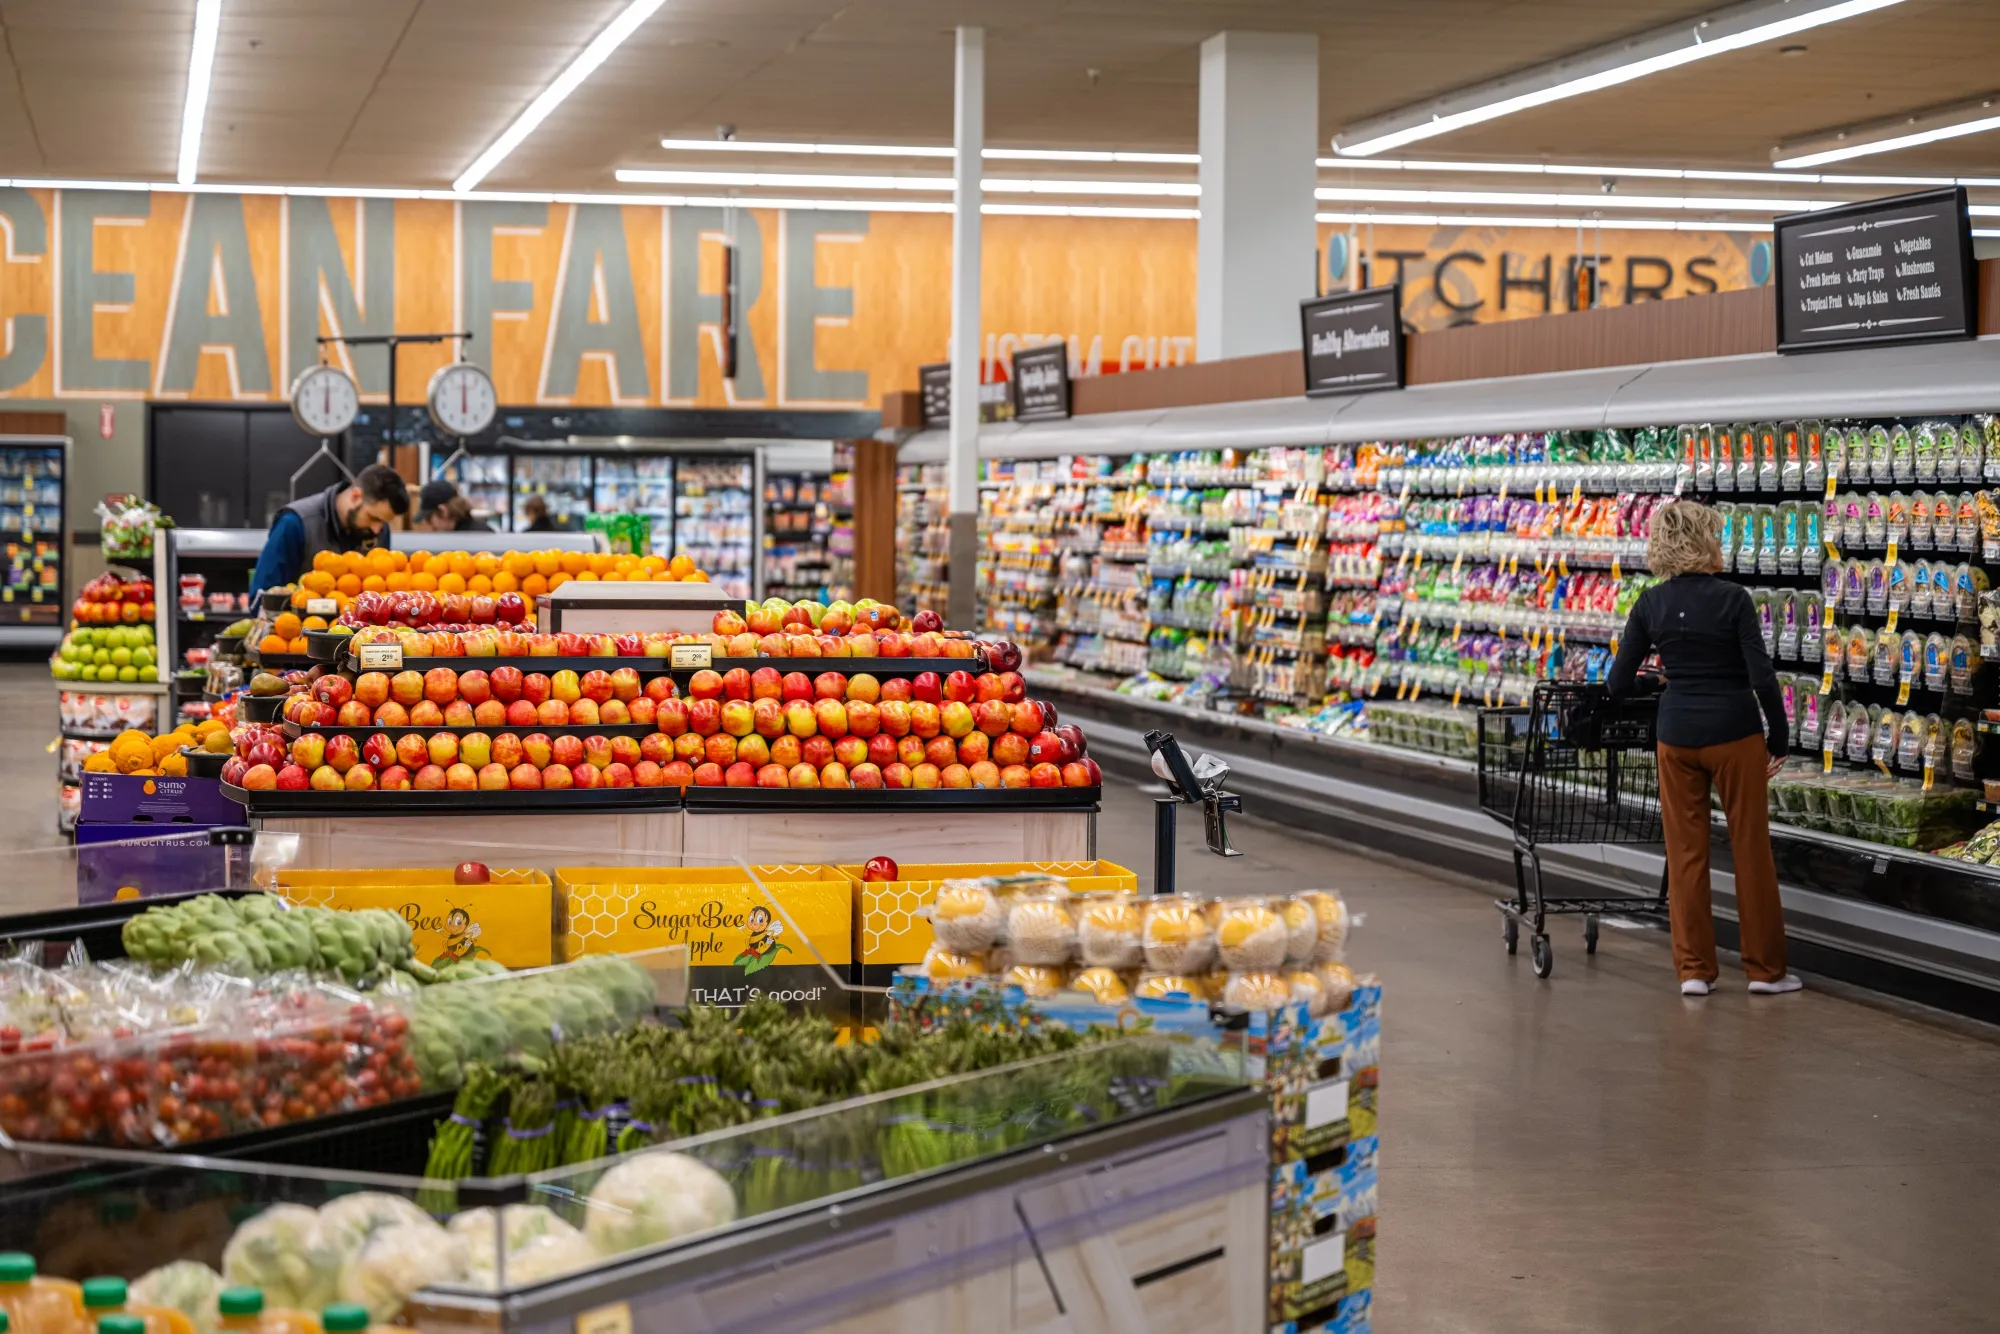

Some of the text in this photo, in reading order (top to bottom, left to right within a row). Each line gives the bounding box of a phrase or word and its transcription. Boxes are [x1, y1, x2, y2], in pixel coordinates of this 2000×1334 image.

[1852, 243, 1882, 260] Guacamole
[1900, 236, 1932, 255] Vegetables
[1805, 251, 1834, 266] Cut Melons
[1853, 266, 1885, 284] Party Trays
[1901, 261, 1935, 276] Mushrooms
[1316, 248, 1719, 312] TCHERS
[1806, 272, 1841, 288] Fresh Berries
[1853, 290, 1889, 309] Dips & Salsa
[1903, 282, 1942, 301] Fresh Sautés
[454, 201, 870, 408] FARE
[1806, 295, 1843, 314] Tropical Fruit
[633, 900, 745, 940] SugarBee
[691, 984, 763, 1002] THAT'S
